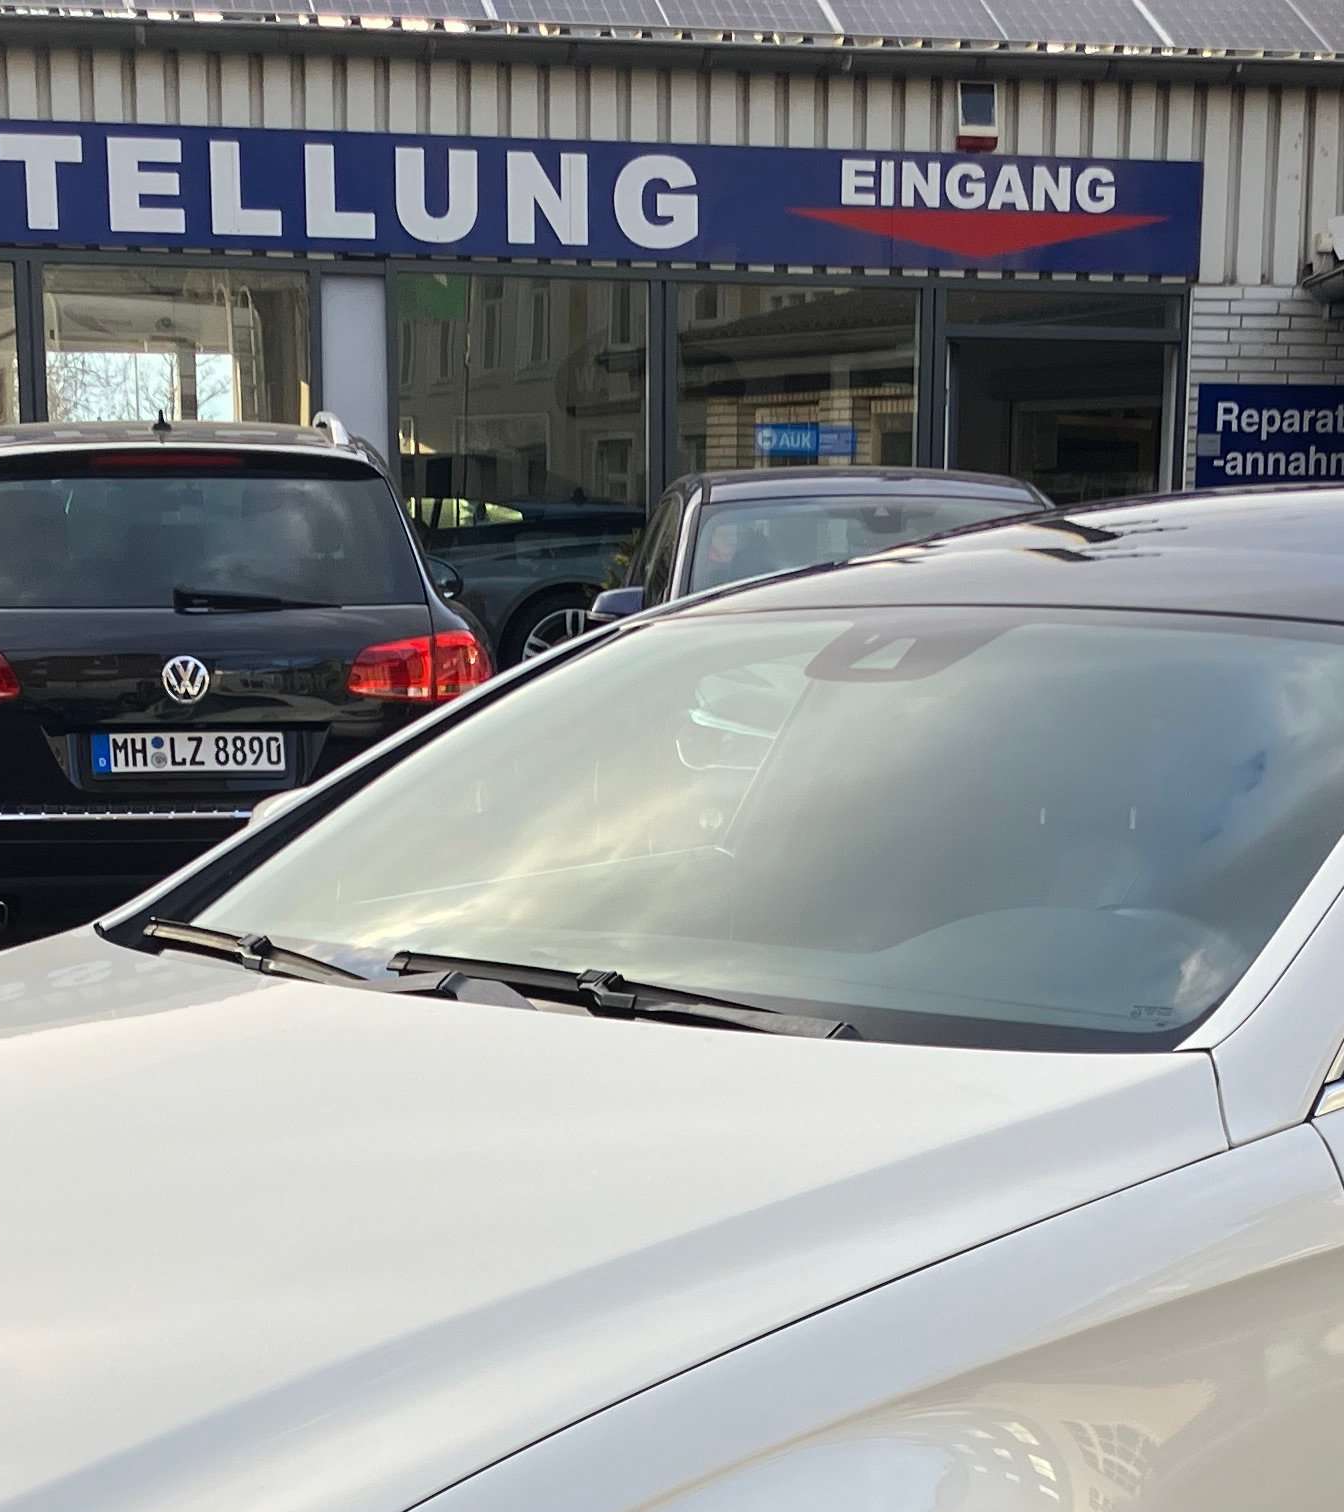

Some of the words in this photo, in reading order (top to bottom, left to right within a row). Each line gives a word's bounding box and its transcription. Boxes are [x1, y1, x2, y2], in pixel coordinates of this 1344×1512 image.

[841, 158, 1116, 214] EINGANG
[112, 737, 148, 767] MH
[170, 736, 206, 766] LZ
[214, 735, 282, 766] 8890
